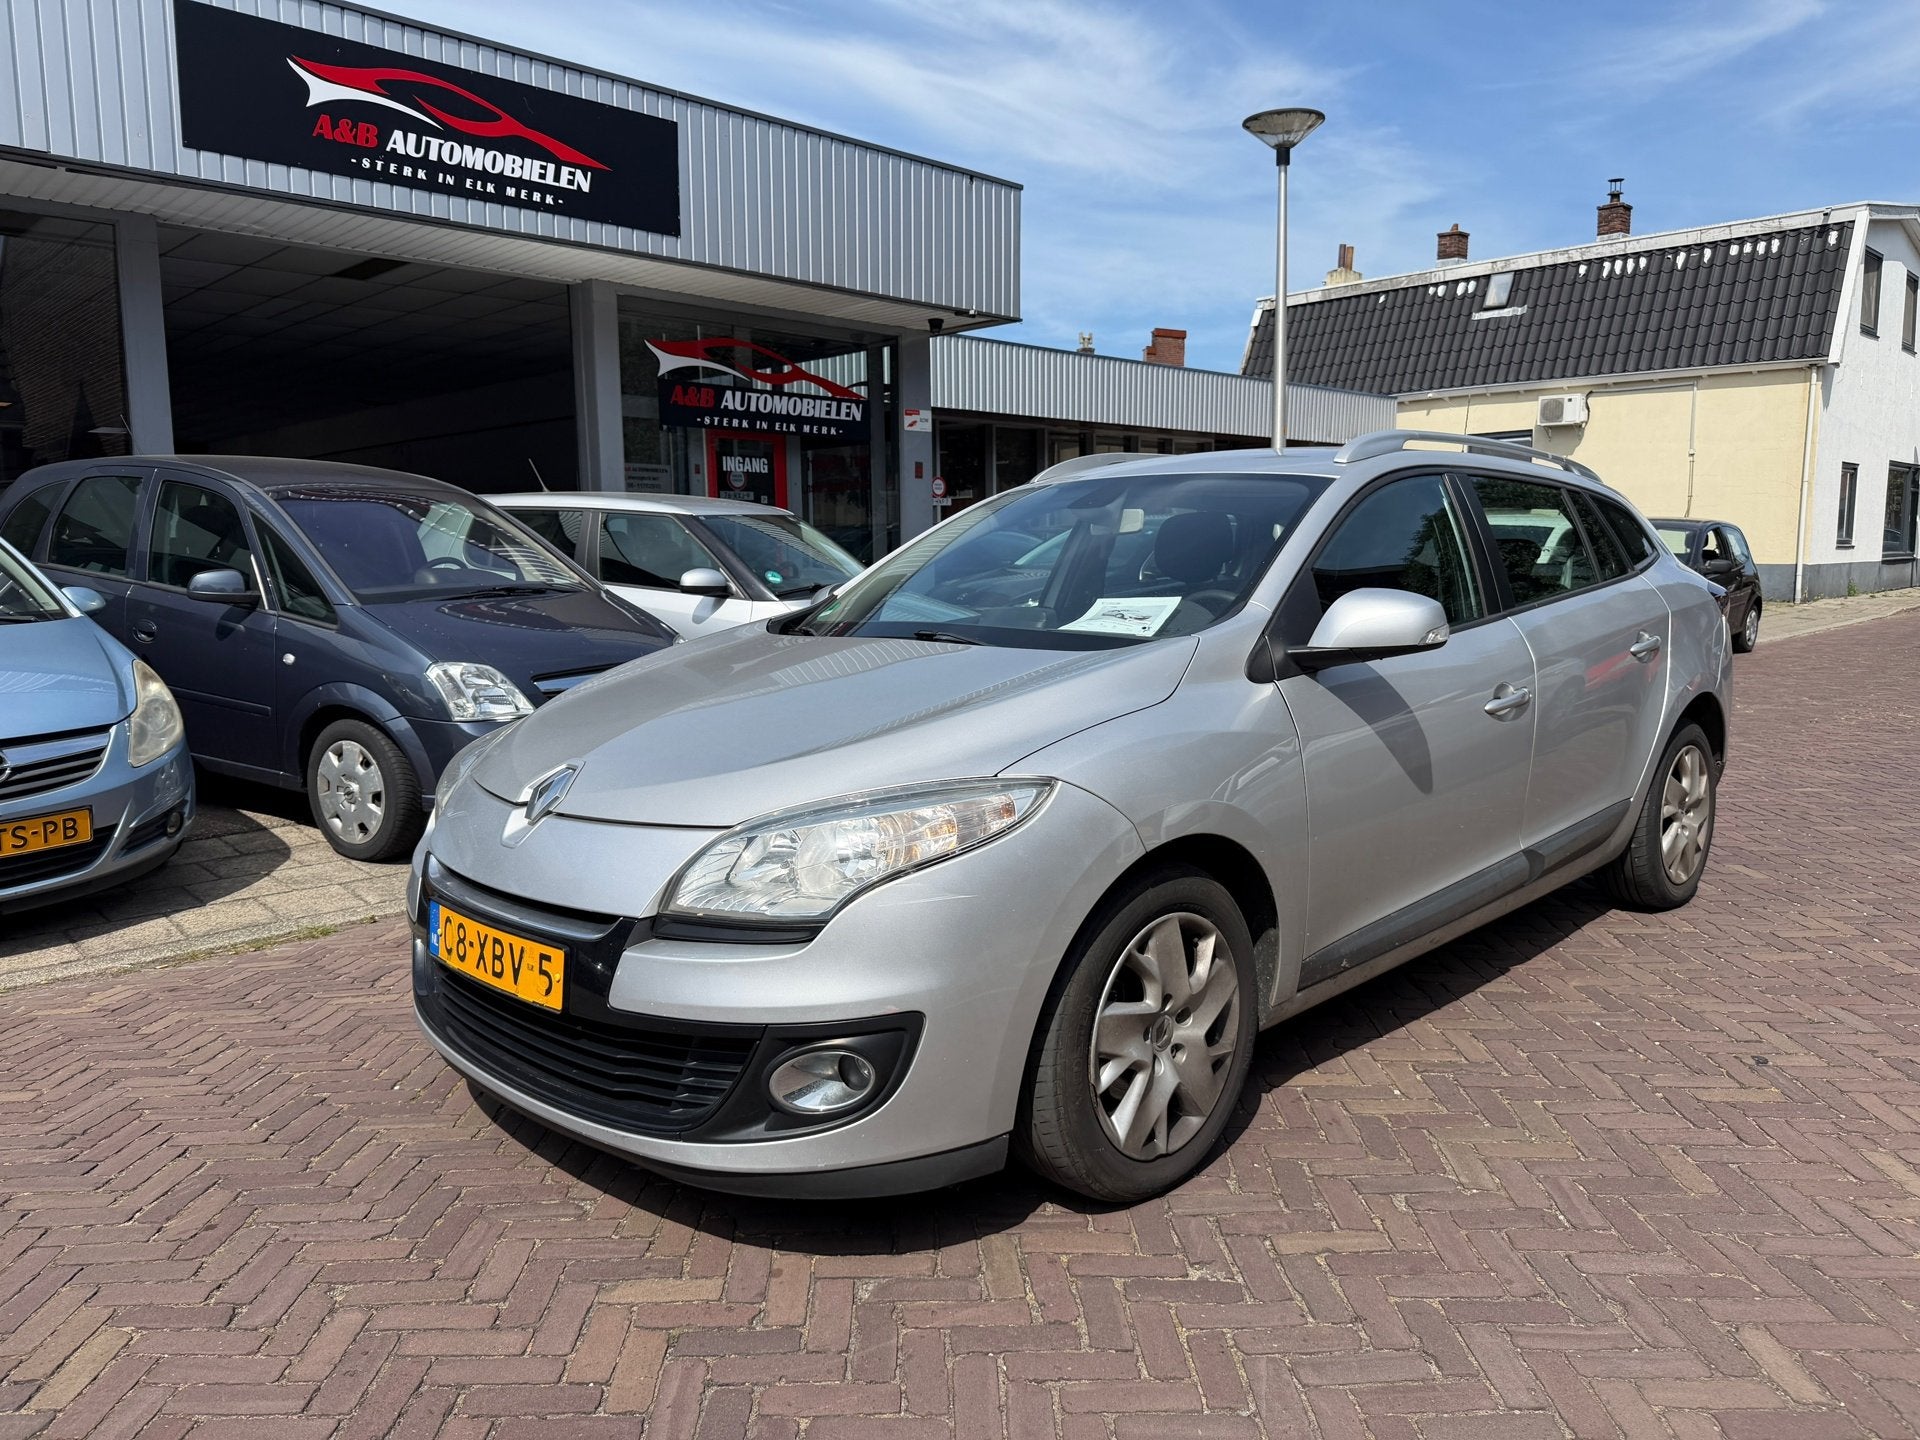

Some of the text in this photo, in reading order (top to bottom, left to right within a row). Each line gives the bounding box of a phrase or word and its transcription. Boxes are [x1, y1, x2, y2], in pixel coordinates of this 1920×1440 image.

[312, 114, 592, 193] A&B AUTOMOBIELEN
[437, 172, 455, 186] IN
[465, 178, 496, 194] ELK
[670, 385, 862, 422] A&B AUTOMOBIELEN
[756, 420, 768, 430] IN
[775, 422, 796, 432] ELK
[722, 455, 769, 474] INGANG
